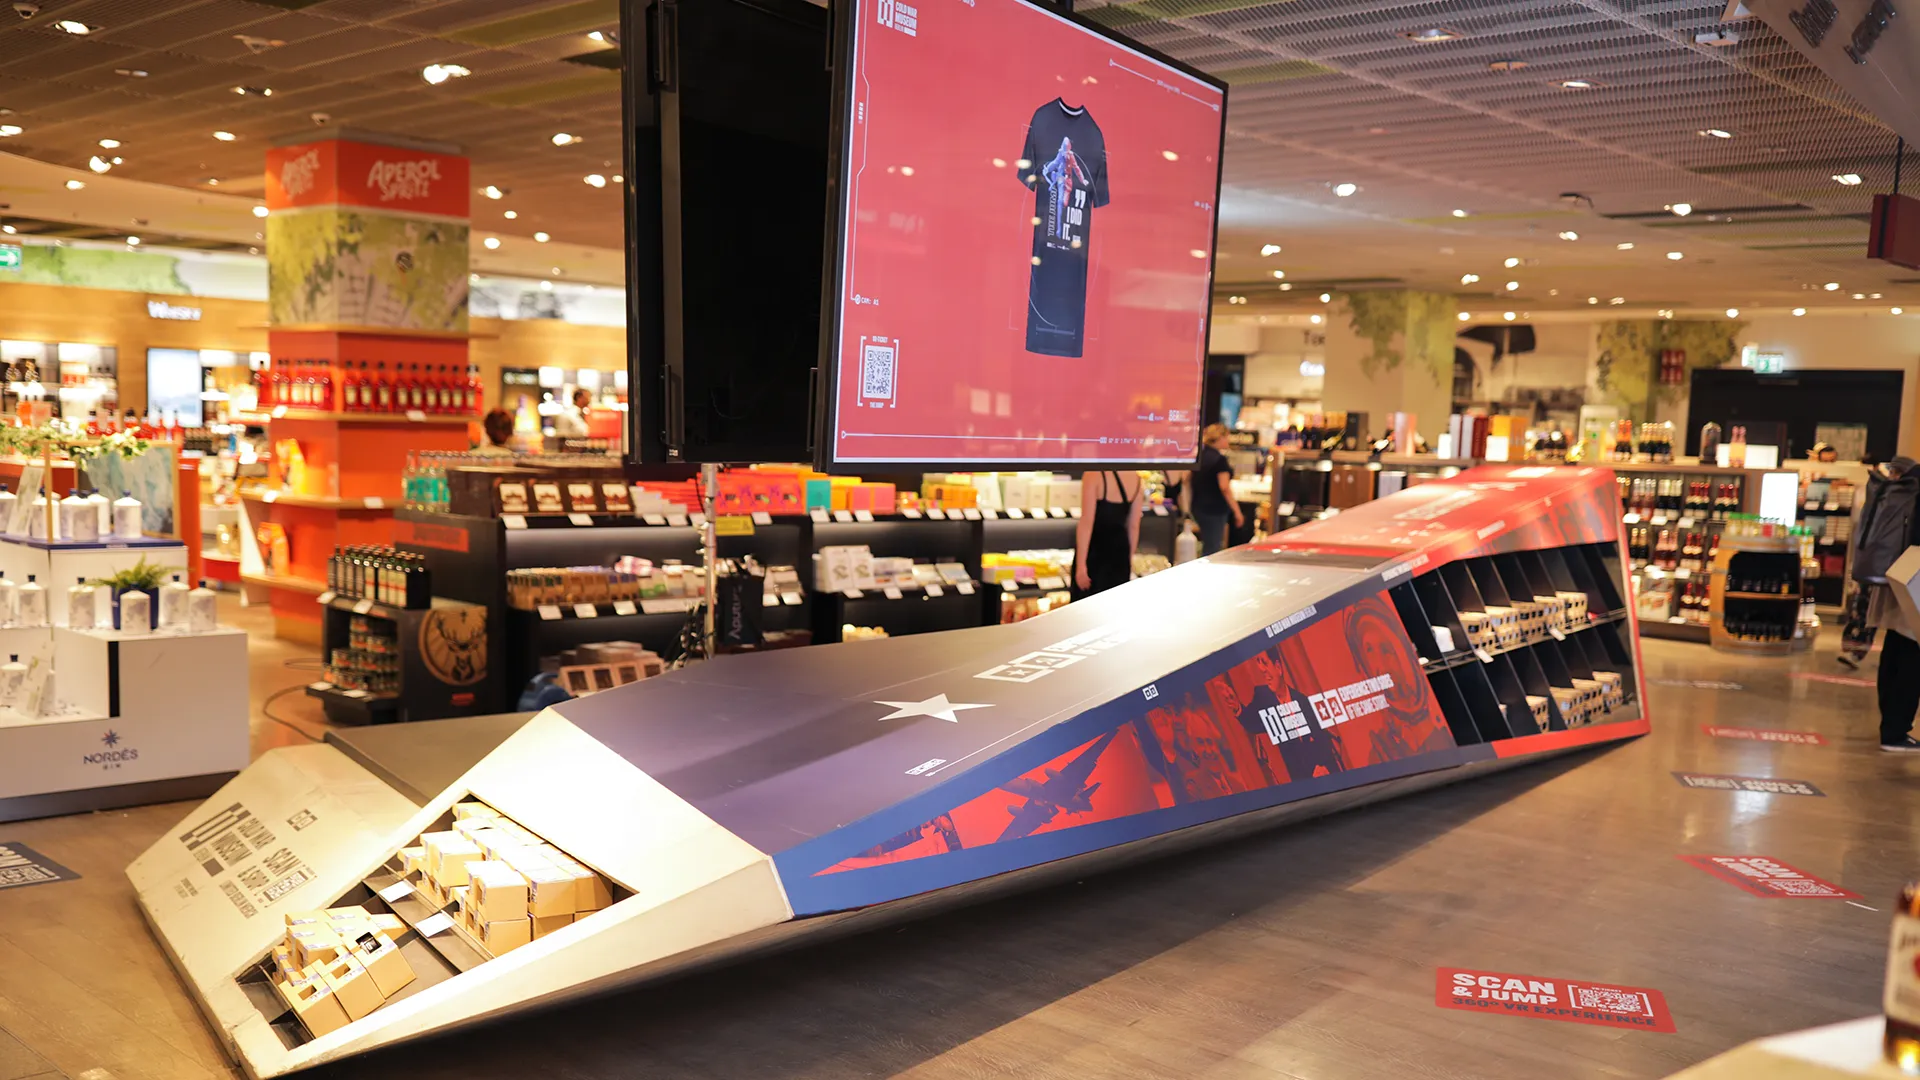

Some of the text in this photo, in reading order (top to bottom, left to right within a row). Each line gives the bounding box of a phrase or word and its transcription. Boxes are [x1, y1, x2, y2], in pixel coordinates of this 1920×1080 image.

[367, 160, 442, 189] APEROL
[380, 180, 430, 201] SPRITZ
[1338, 673, 1394, 703] EXPERIENCE TWO SIDES
[1276, 700, 1301, 717] COLD WAR
[1281, 711, 1308, 731] MUSEUM
[237, 817, 276, 850] COLD WAR
[210, 831, 253, 867] MUSEUM
[263, 848, 302, 877] SCAN
[1452, 986, 1558, 1005] & JUMP
[1453, 973, 1555, 995] SCAN
[1452, 997, 1657, 1027] 360° VR EXPERIENCE
